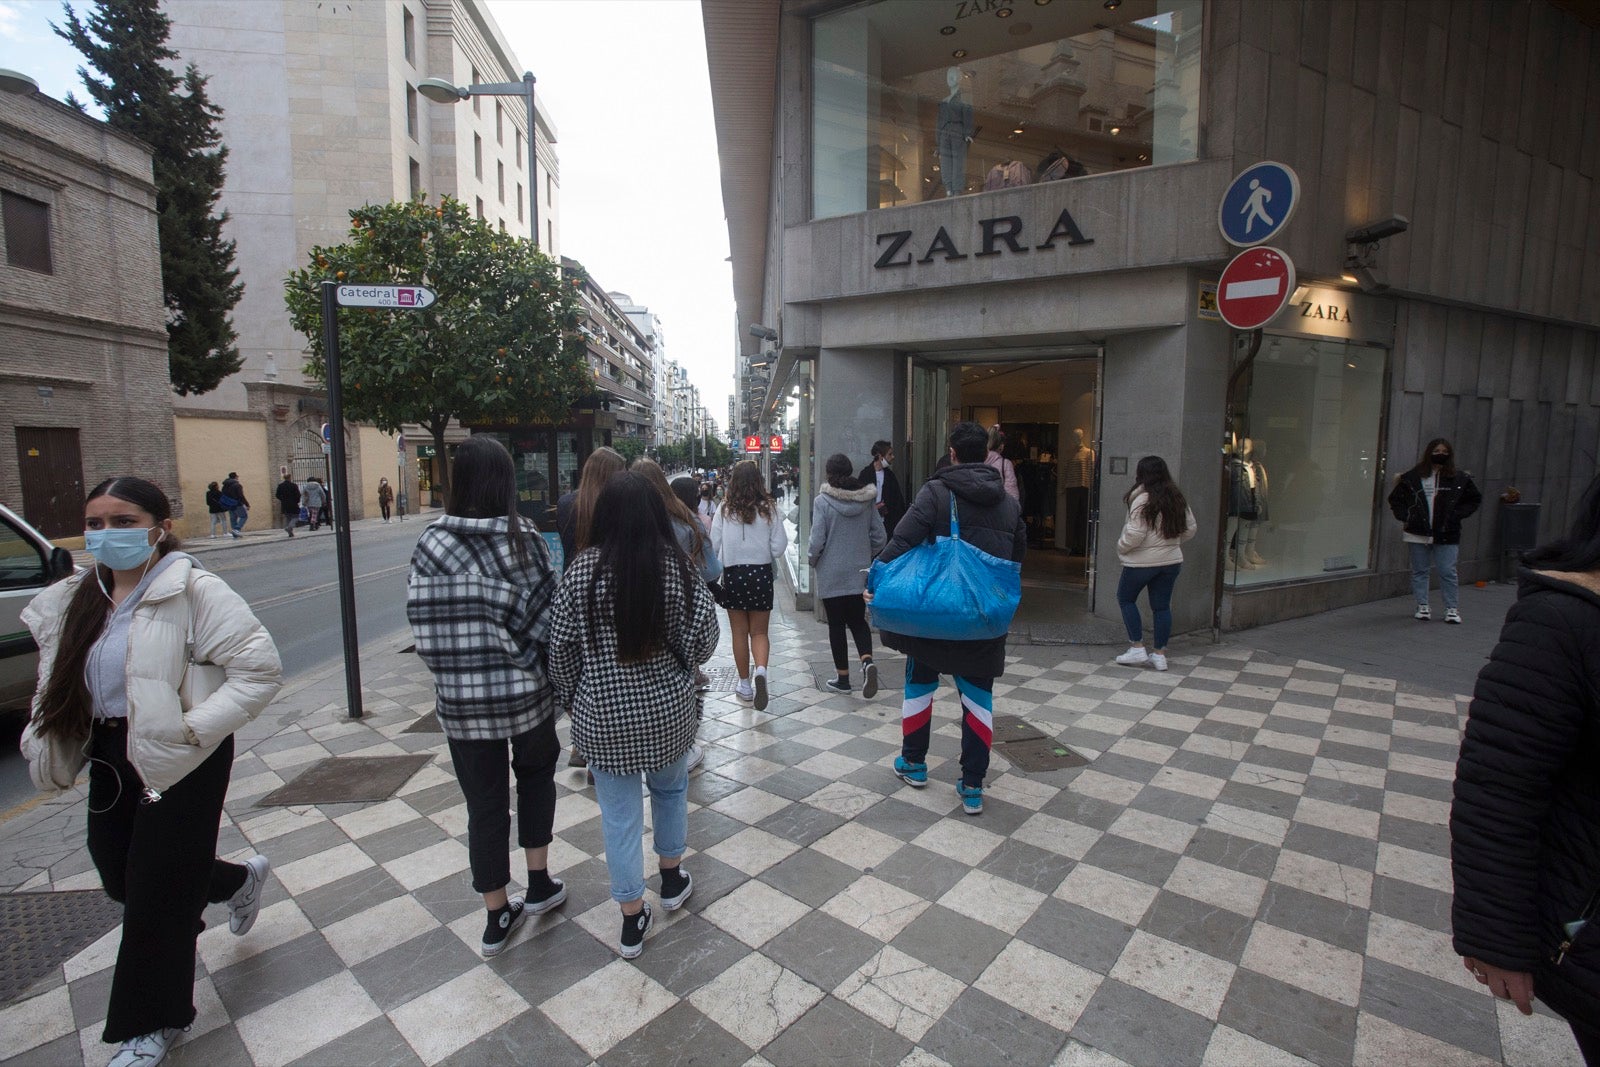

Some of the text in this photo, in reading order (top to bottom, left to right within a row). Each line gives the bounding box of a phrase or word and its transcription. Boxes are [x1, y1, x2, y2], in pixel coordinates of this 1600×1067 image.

[874, 208, 1094, 269] ZARA
[340, 287, 398, 298] Catedral
[1300, 301, 1353, 323] ZARA
